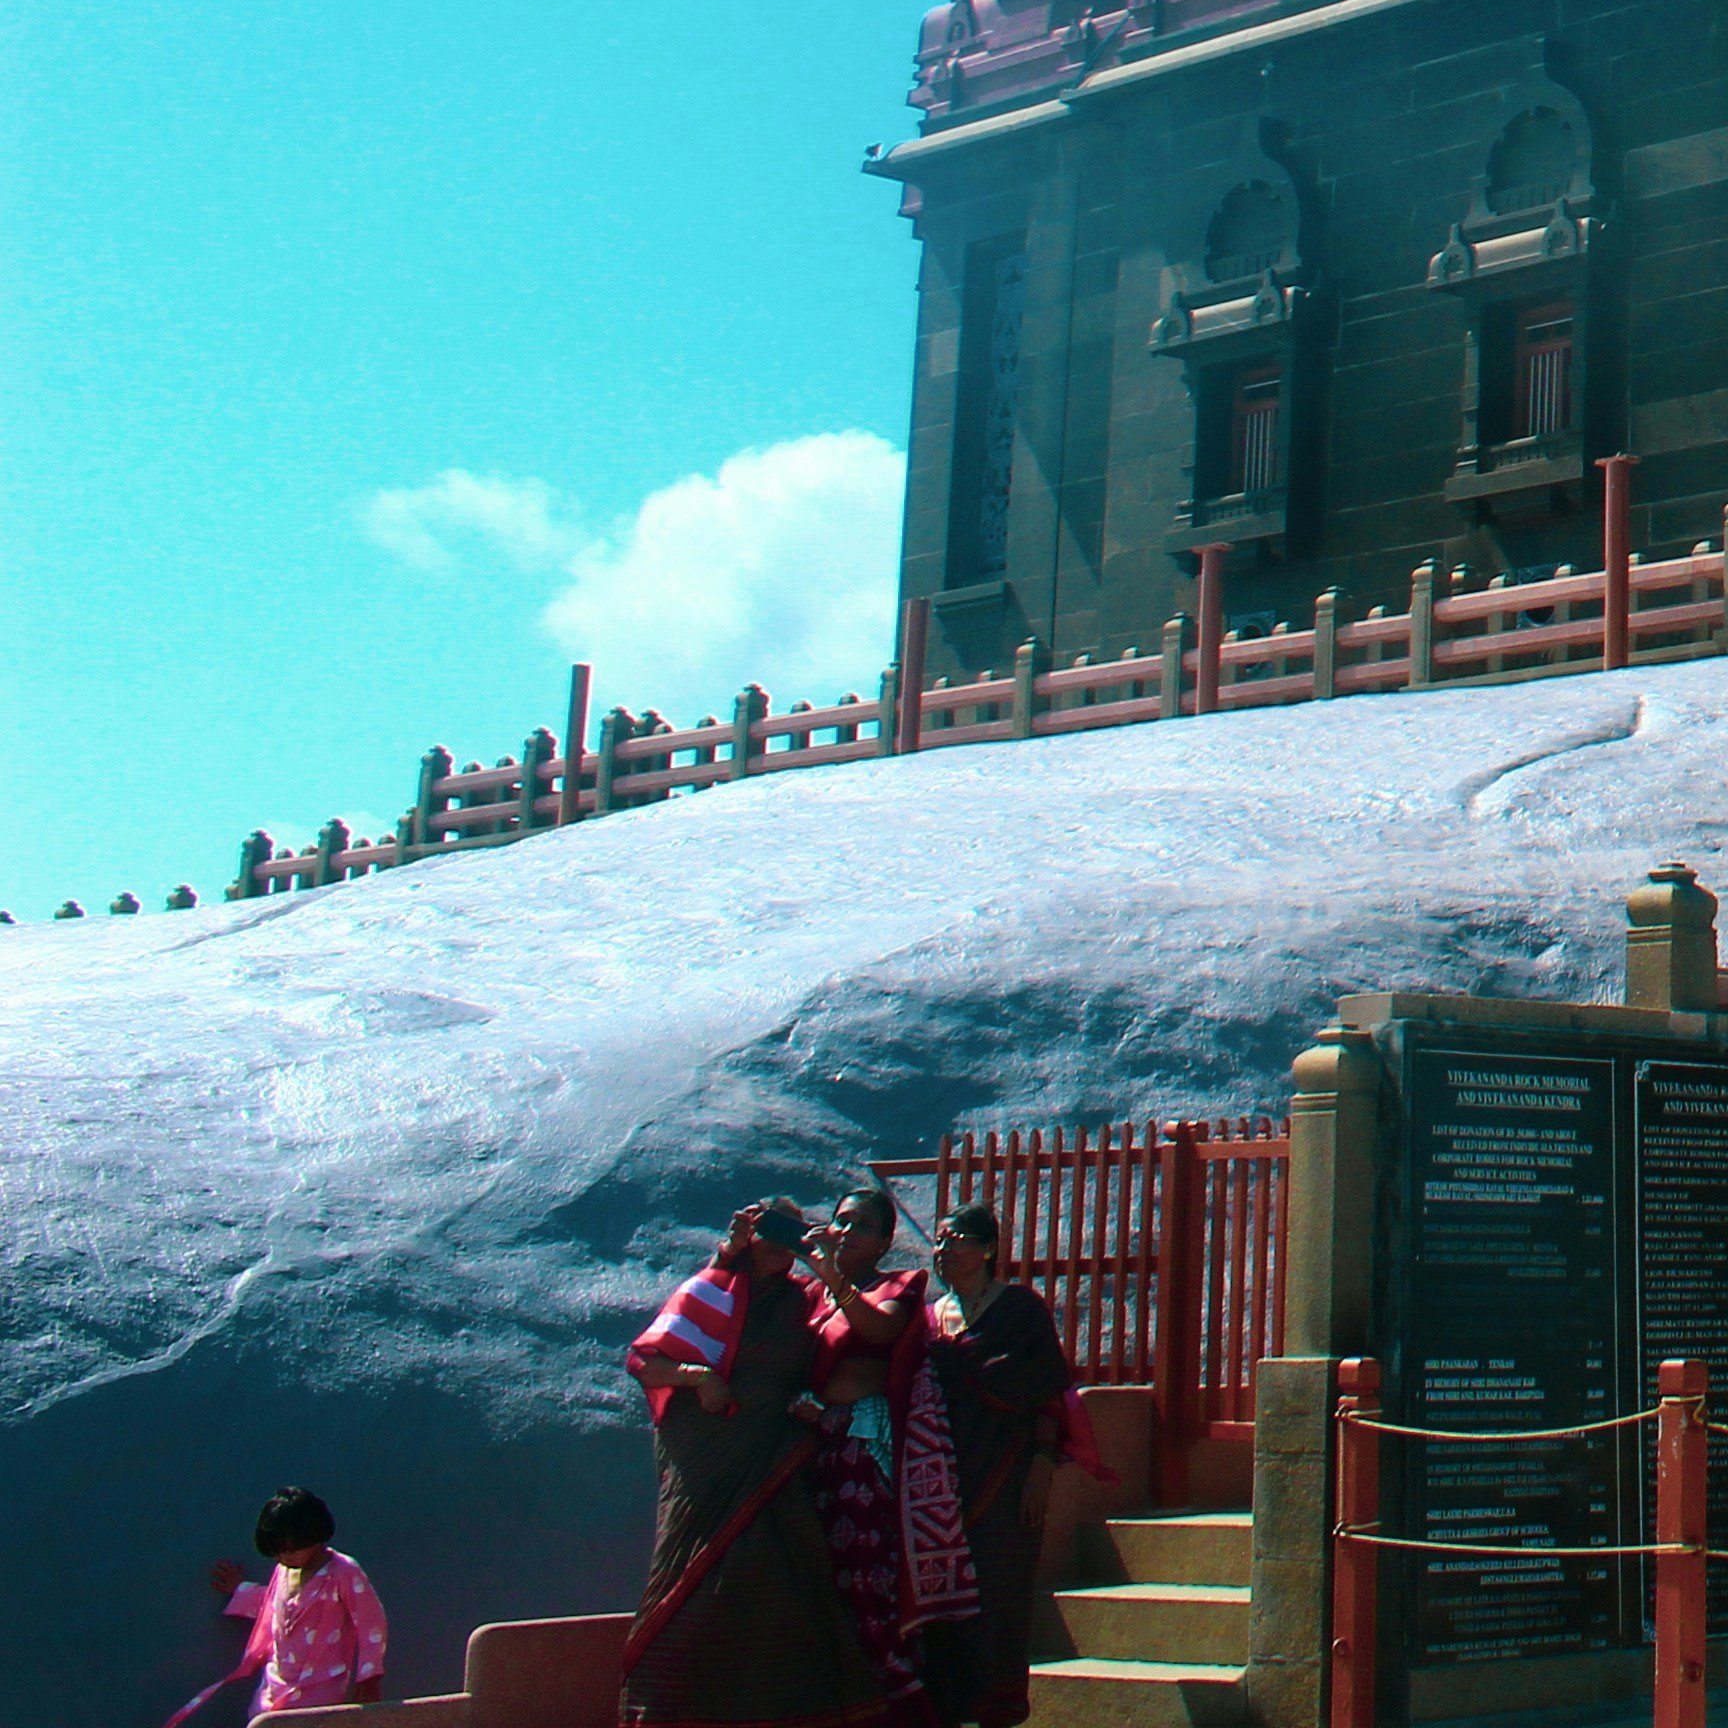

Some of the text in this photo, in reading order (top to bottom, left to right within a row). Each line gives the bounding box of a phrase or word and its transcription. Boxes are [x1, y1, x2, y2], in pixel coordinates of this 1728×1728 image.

[1447, 1070, 1590, 1089] VIVEKANANDA ROCK MEMORIAL
[1652, 1081, 1719, 1097] VIVEKANANDA
[1457, 1091, 1581, 1109] AND VIVEKANANDA KENDRA
[1663, 1100, 1683, 1113] AND
